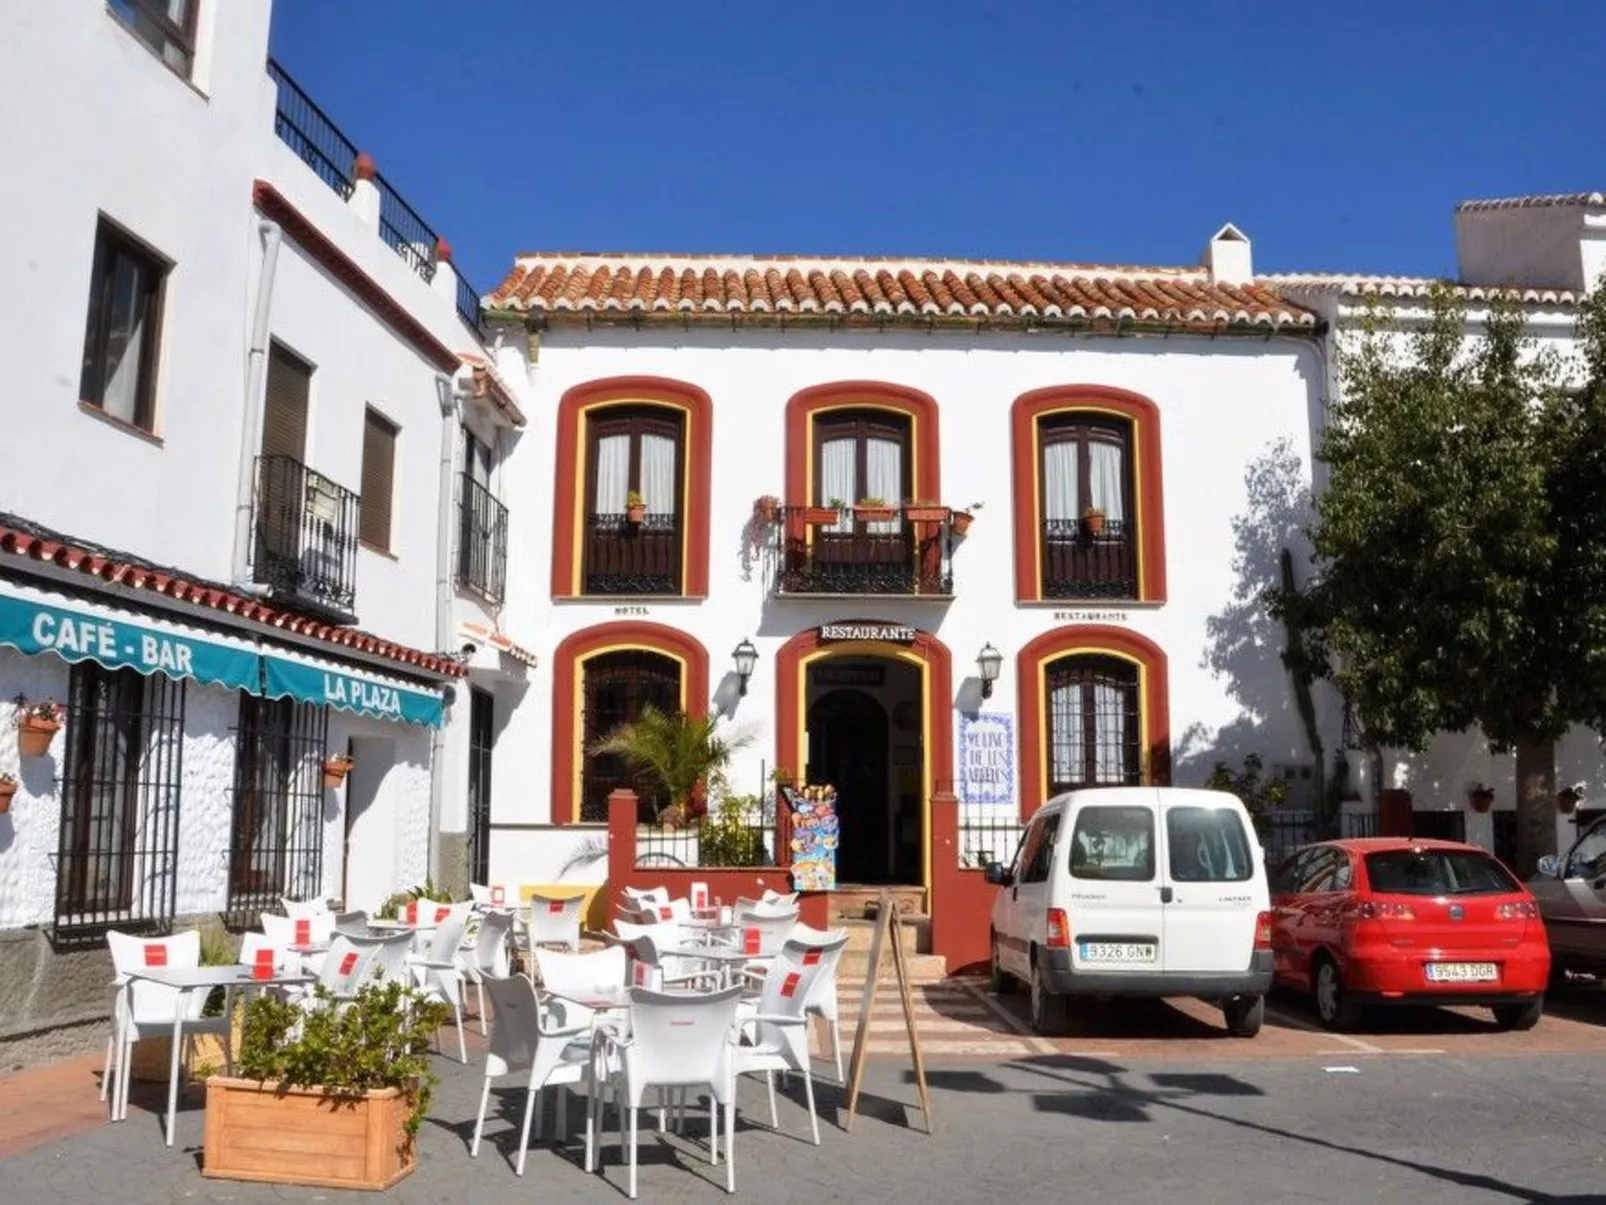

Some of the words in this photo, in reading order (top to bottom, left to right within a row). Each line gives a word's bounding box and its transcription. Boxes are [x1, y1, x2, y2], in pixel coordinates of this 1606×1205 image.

[1053, 611, 1128, 621] RESTAURANTE
[821, 625, 916, 640] RESTAURANTE
[32, 611, 117, 659] CAFÉ
[141, 634, 194, 675] BAR
[323, 673, 348, 703] LA
[350, 680, 401, 714] PLAZA
[1090, 945, 1123, 959] 9326
